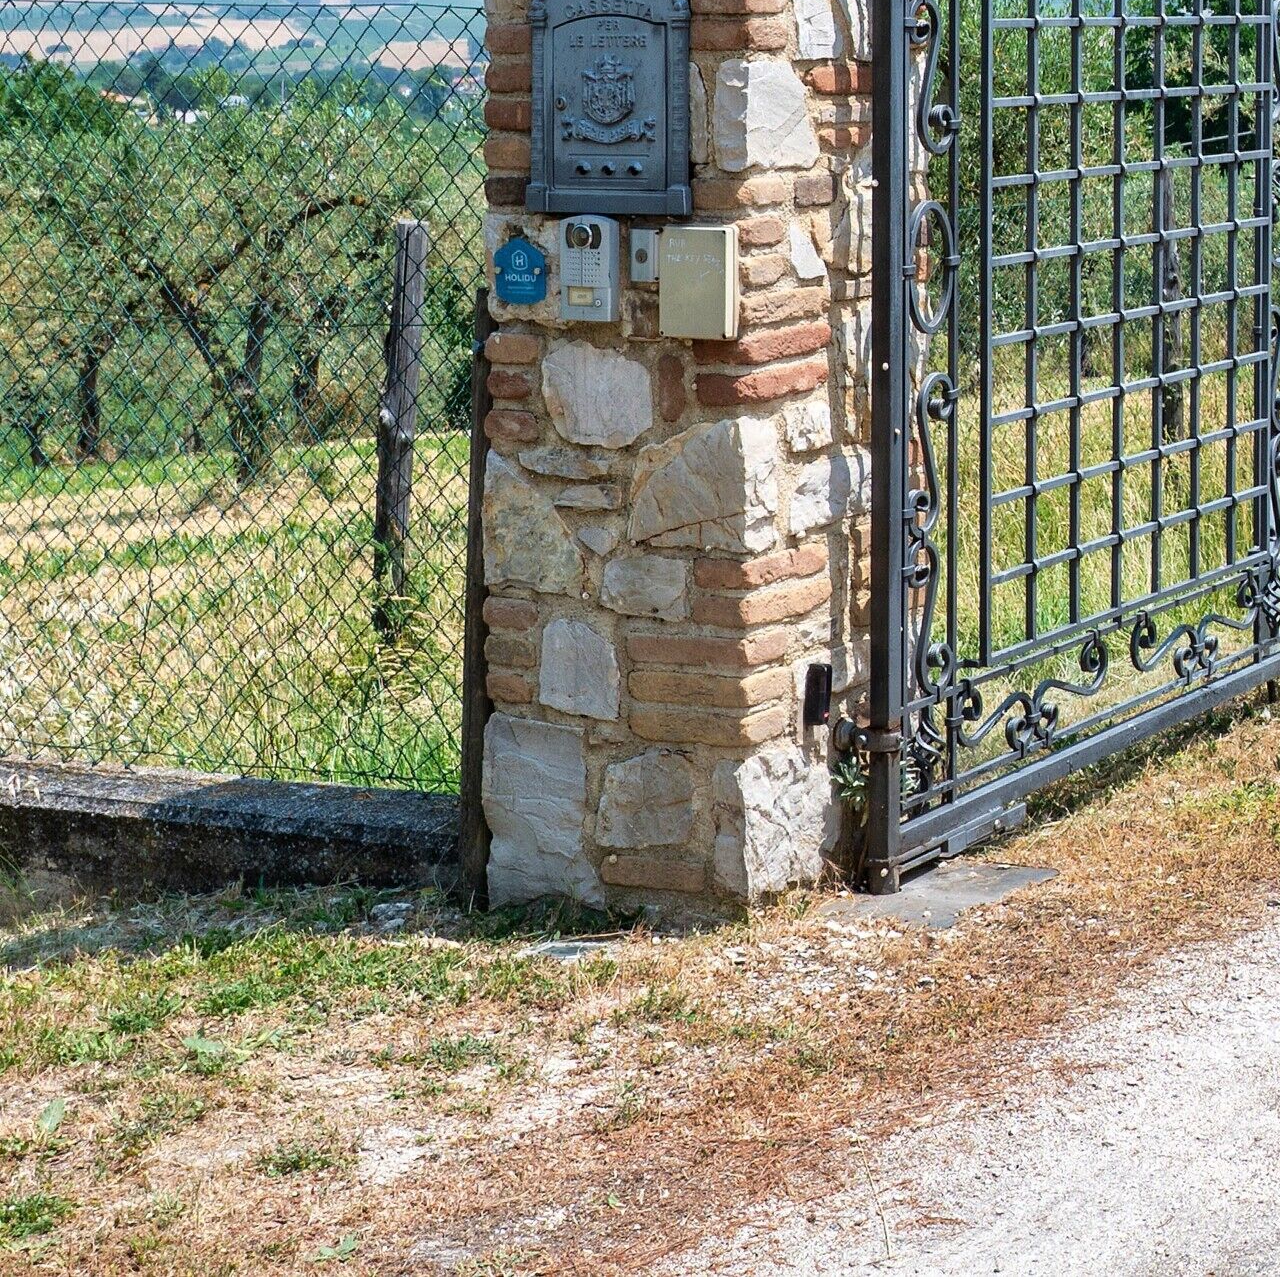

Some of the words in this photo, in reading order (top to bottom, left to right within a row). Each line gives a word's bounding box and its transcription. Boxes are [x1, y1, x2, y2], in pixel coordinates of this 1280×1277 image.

[565, 0, 654, 20] CASSETTA
[597, 20, 620, 31] PER
[570, 35, 584, 48] LE
[591, 35, 647, 48] LETTERE
[505, 273, 537, 283] HOLIDU
